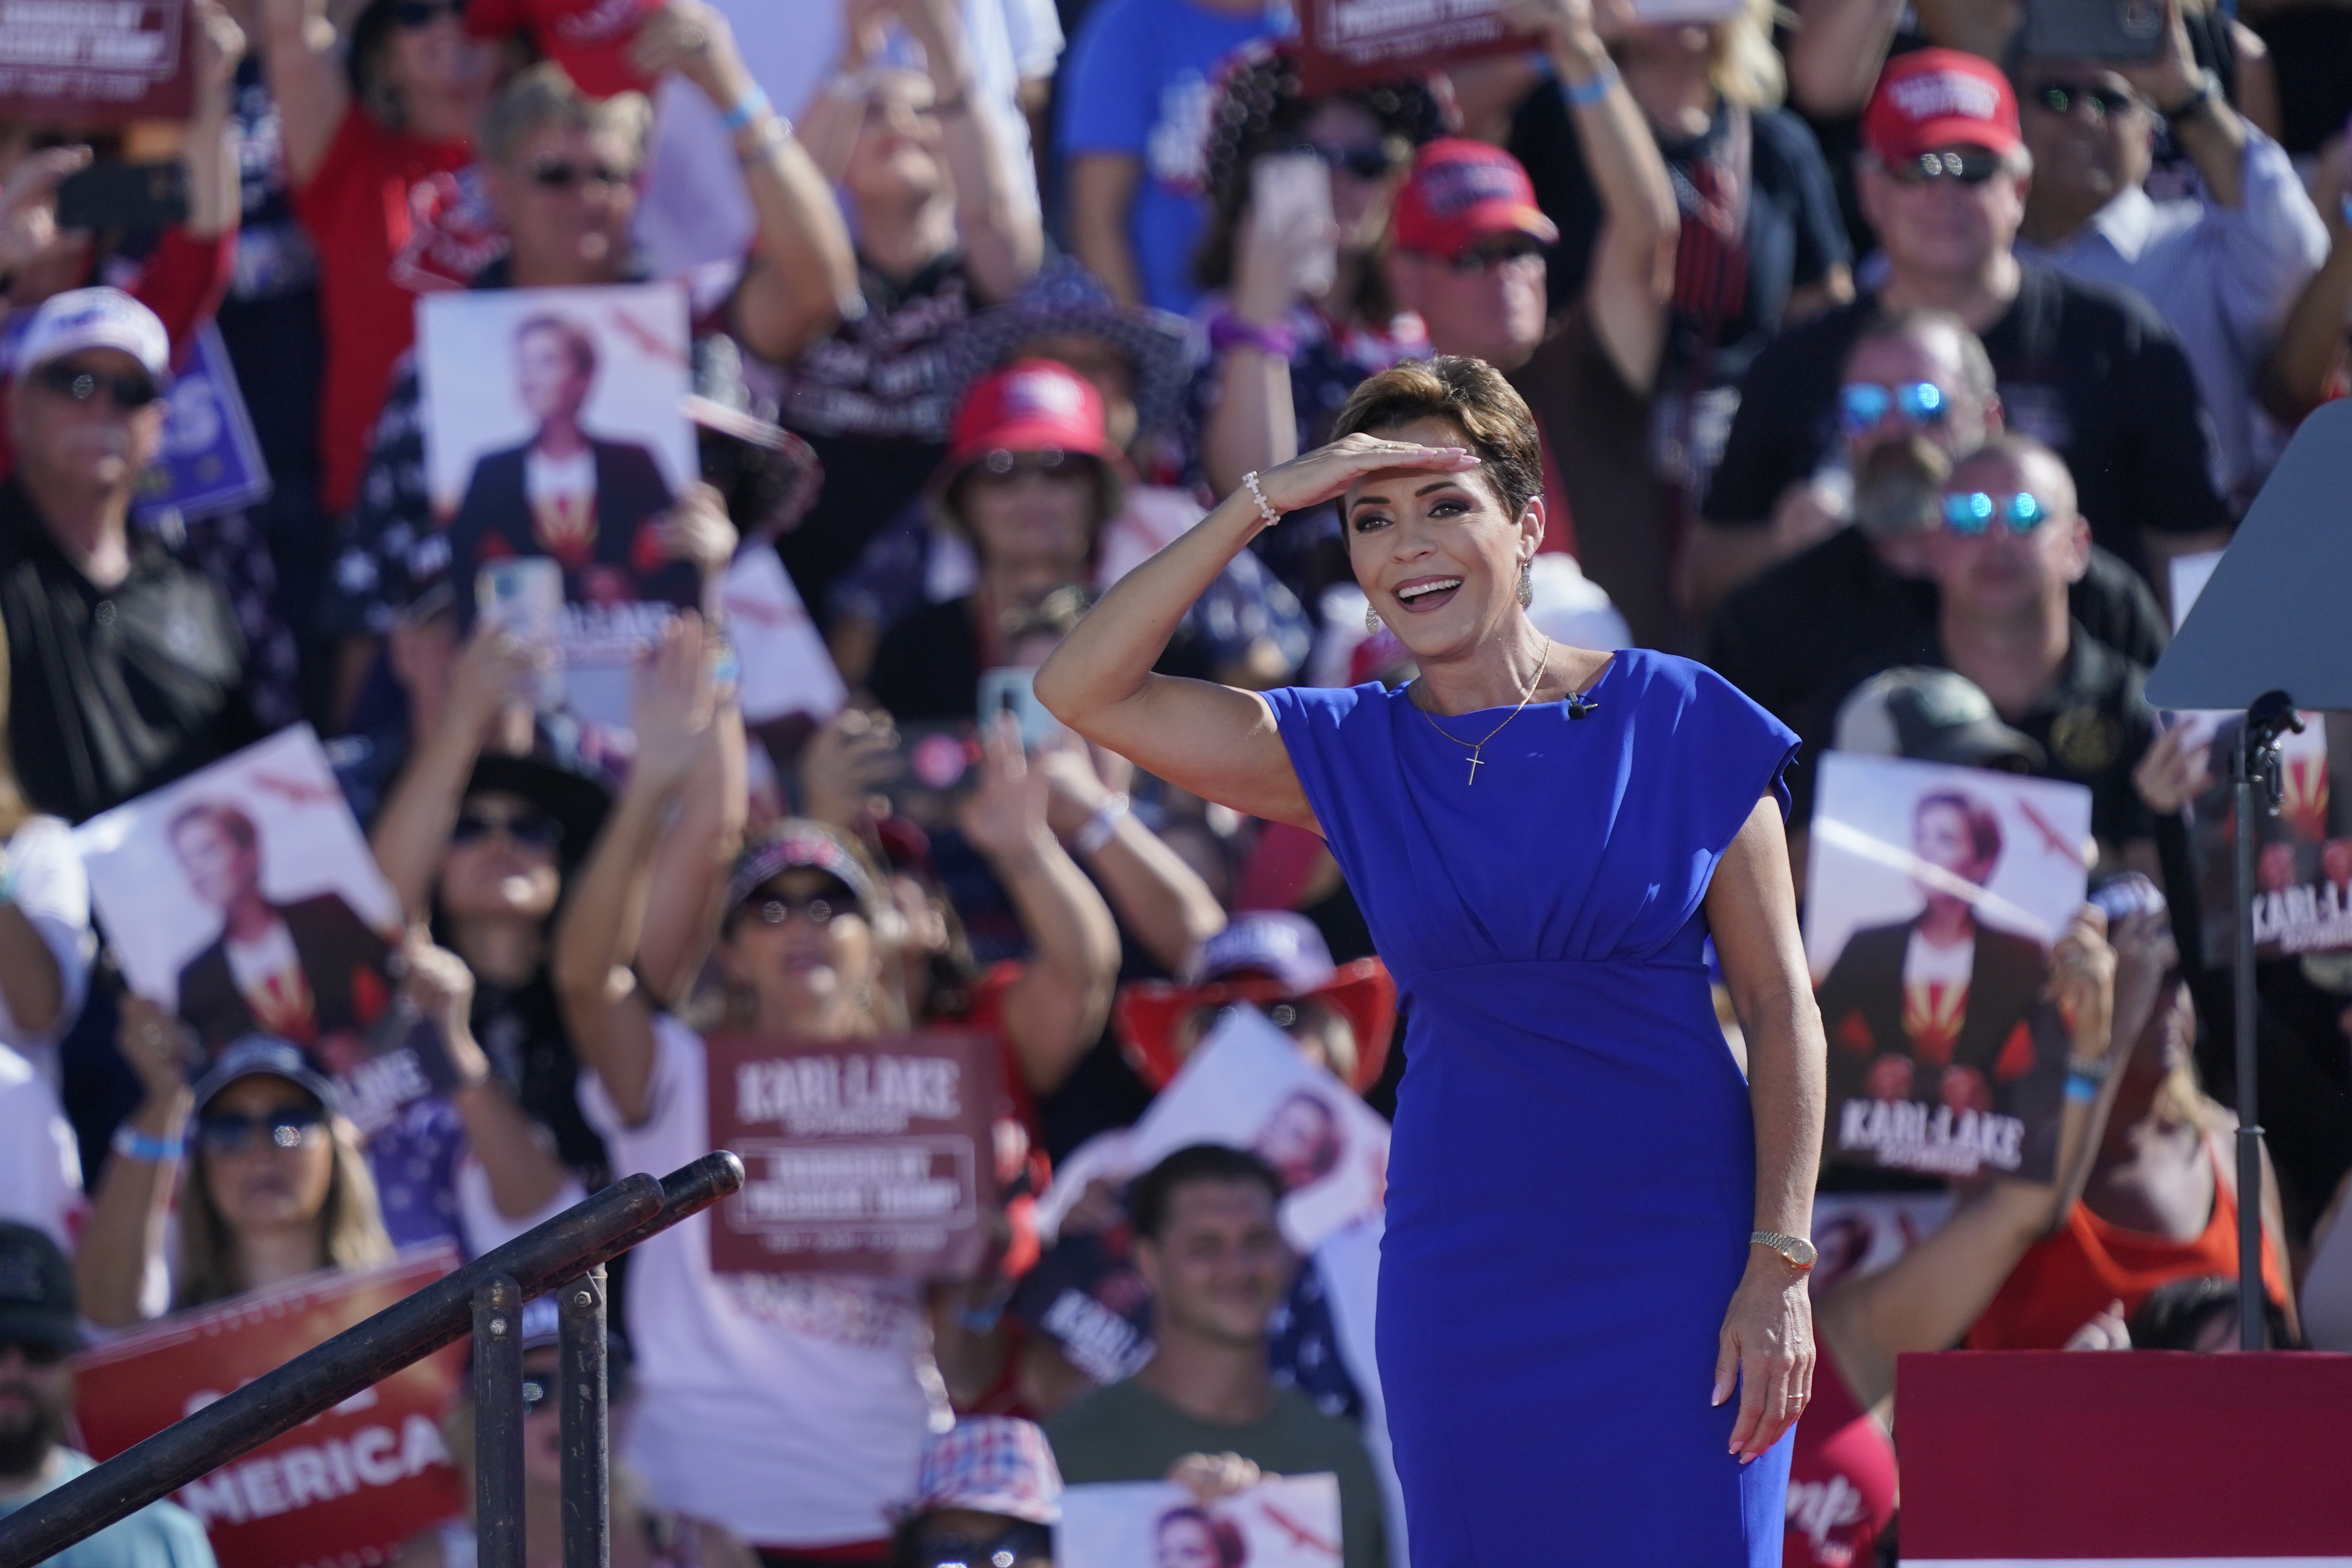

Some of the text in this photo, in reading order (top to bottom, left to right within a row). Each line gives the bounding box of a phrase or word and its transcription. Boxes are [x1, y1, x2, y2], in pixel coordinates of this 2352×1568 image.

[738, 1054, 960, 1123] KARI LAKE
[1839, 1098, 1928, 1150] KARI
[1932, 1103, 2024, 1171] LAKE
[180, 1413, 451, 1529] MERICA
